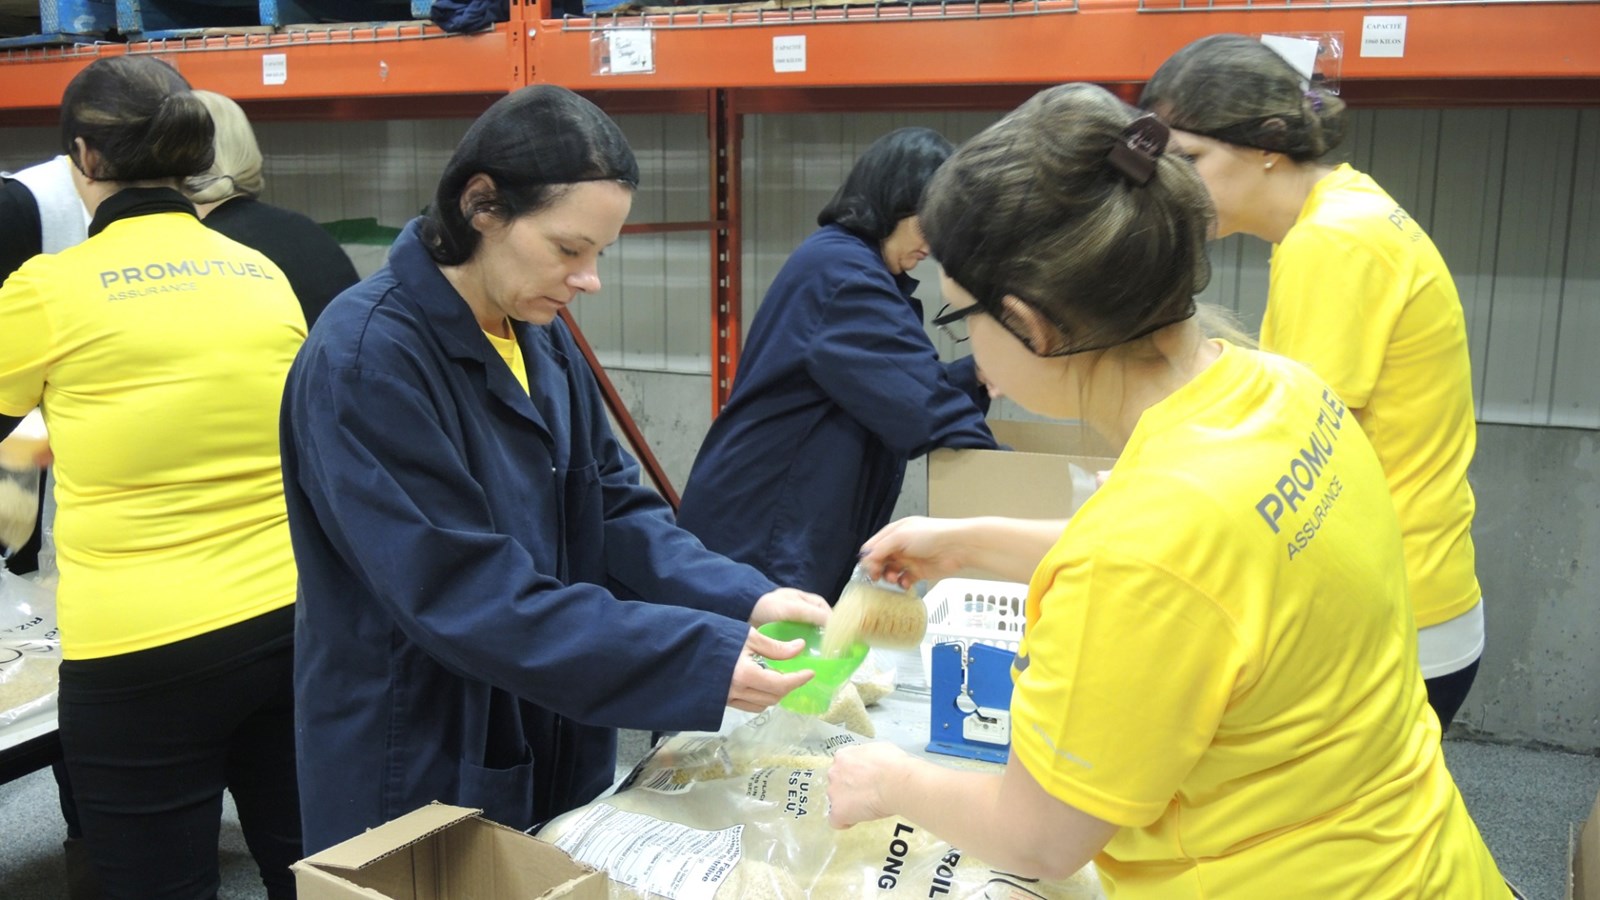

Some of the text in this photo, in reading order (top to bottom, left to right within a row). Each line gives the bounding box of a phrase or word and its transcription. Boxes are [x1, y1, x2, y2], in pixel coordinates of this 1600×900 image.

[100, 260, 274, 288] PROMUTUEL
[107, 281, 199, 302] ASSURANCE
[1287, 475, 1343, 560] ASSURANCE
[795, 783, 809, 819] U.S.A.
[711, 862, 731, 882] Facts
[877, 822, 914, 890] LONG
